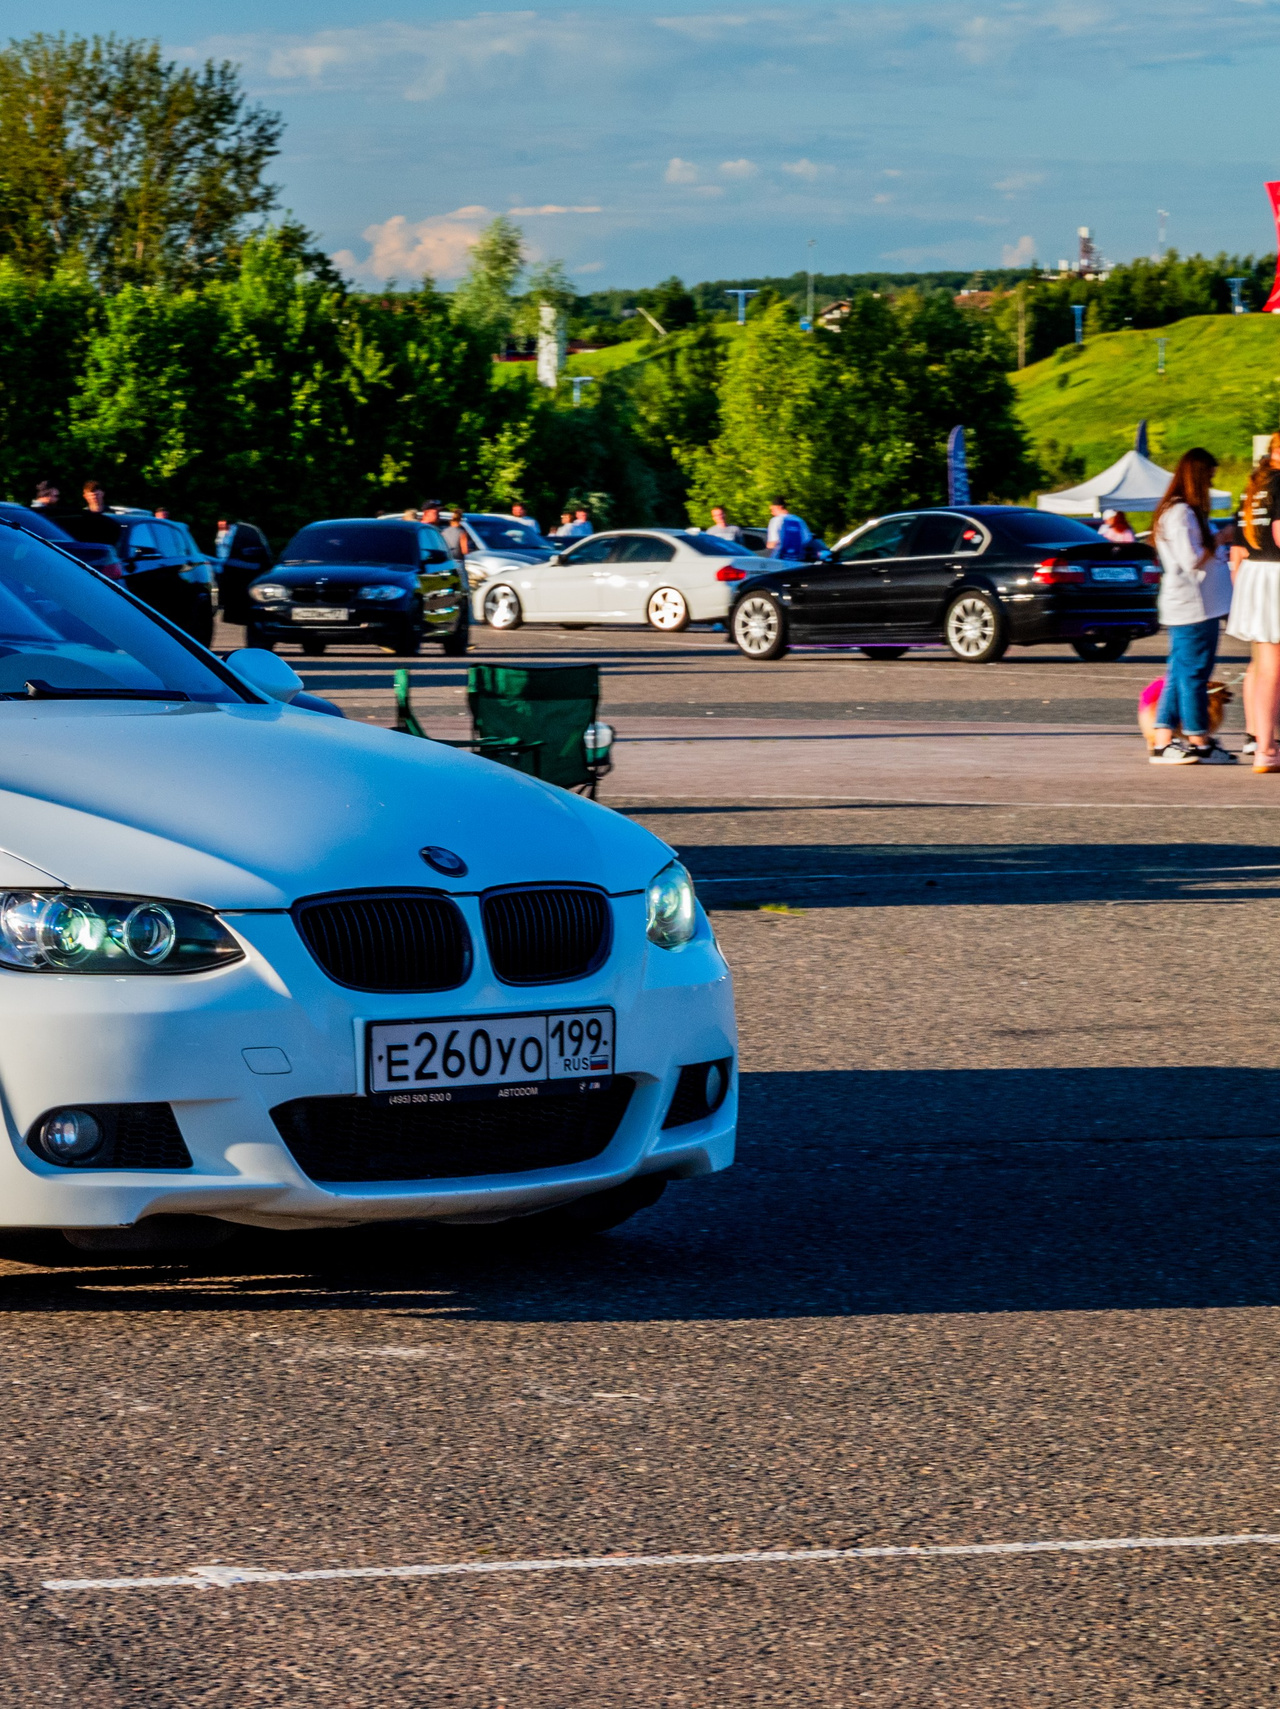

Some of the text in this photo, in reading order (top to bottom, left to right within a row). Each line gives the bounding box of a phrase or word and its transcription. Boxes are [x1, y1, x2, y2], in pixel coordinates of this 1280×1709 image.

[386, 1018, 602, 1083] E260YO 199
[563, 1057, 589, 1072] RUS
